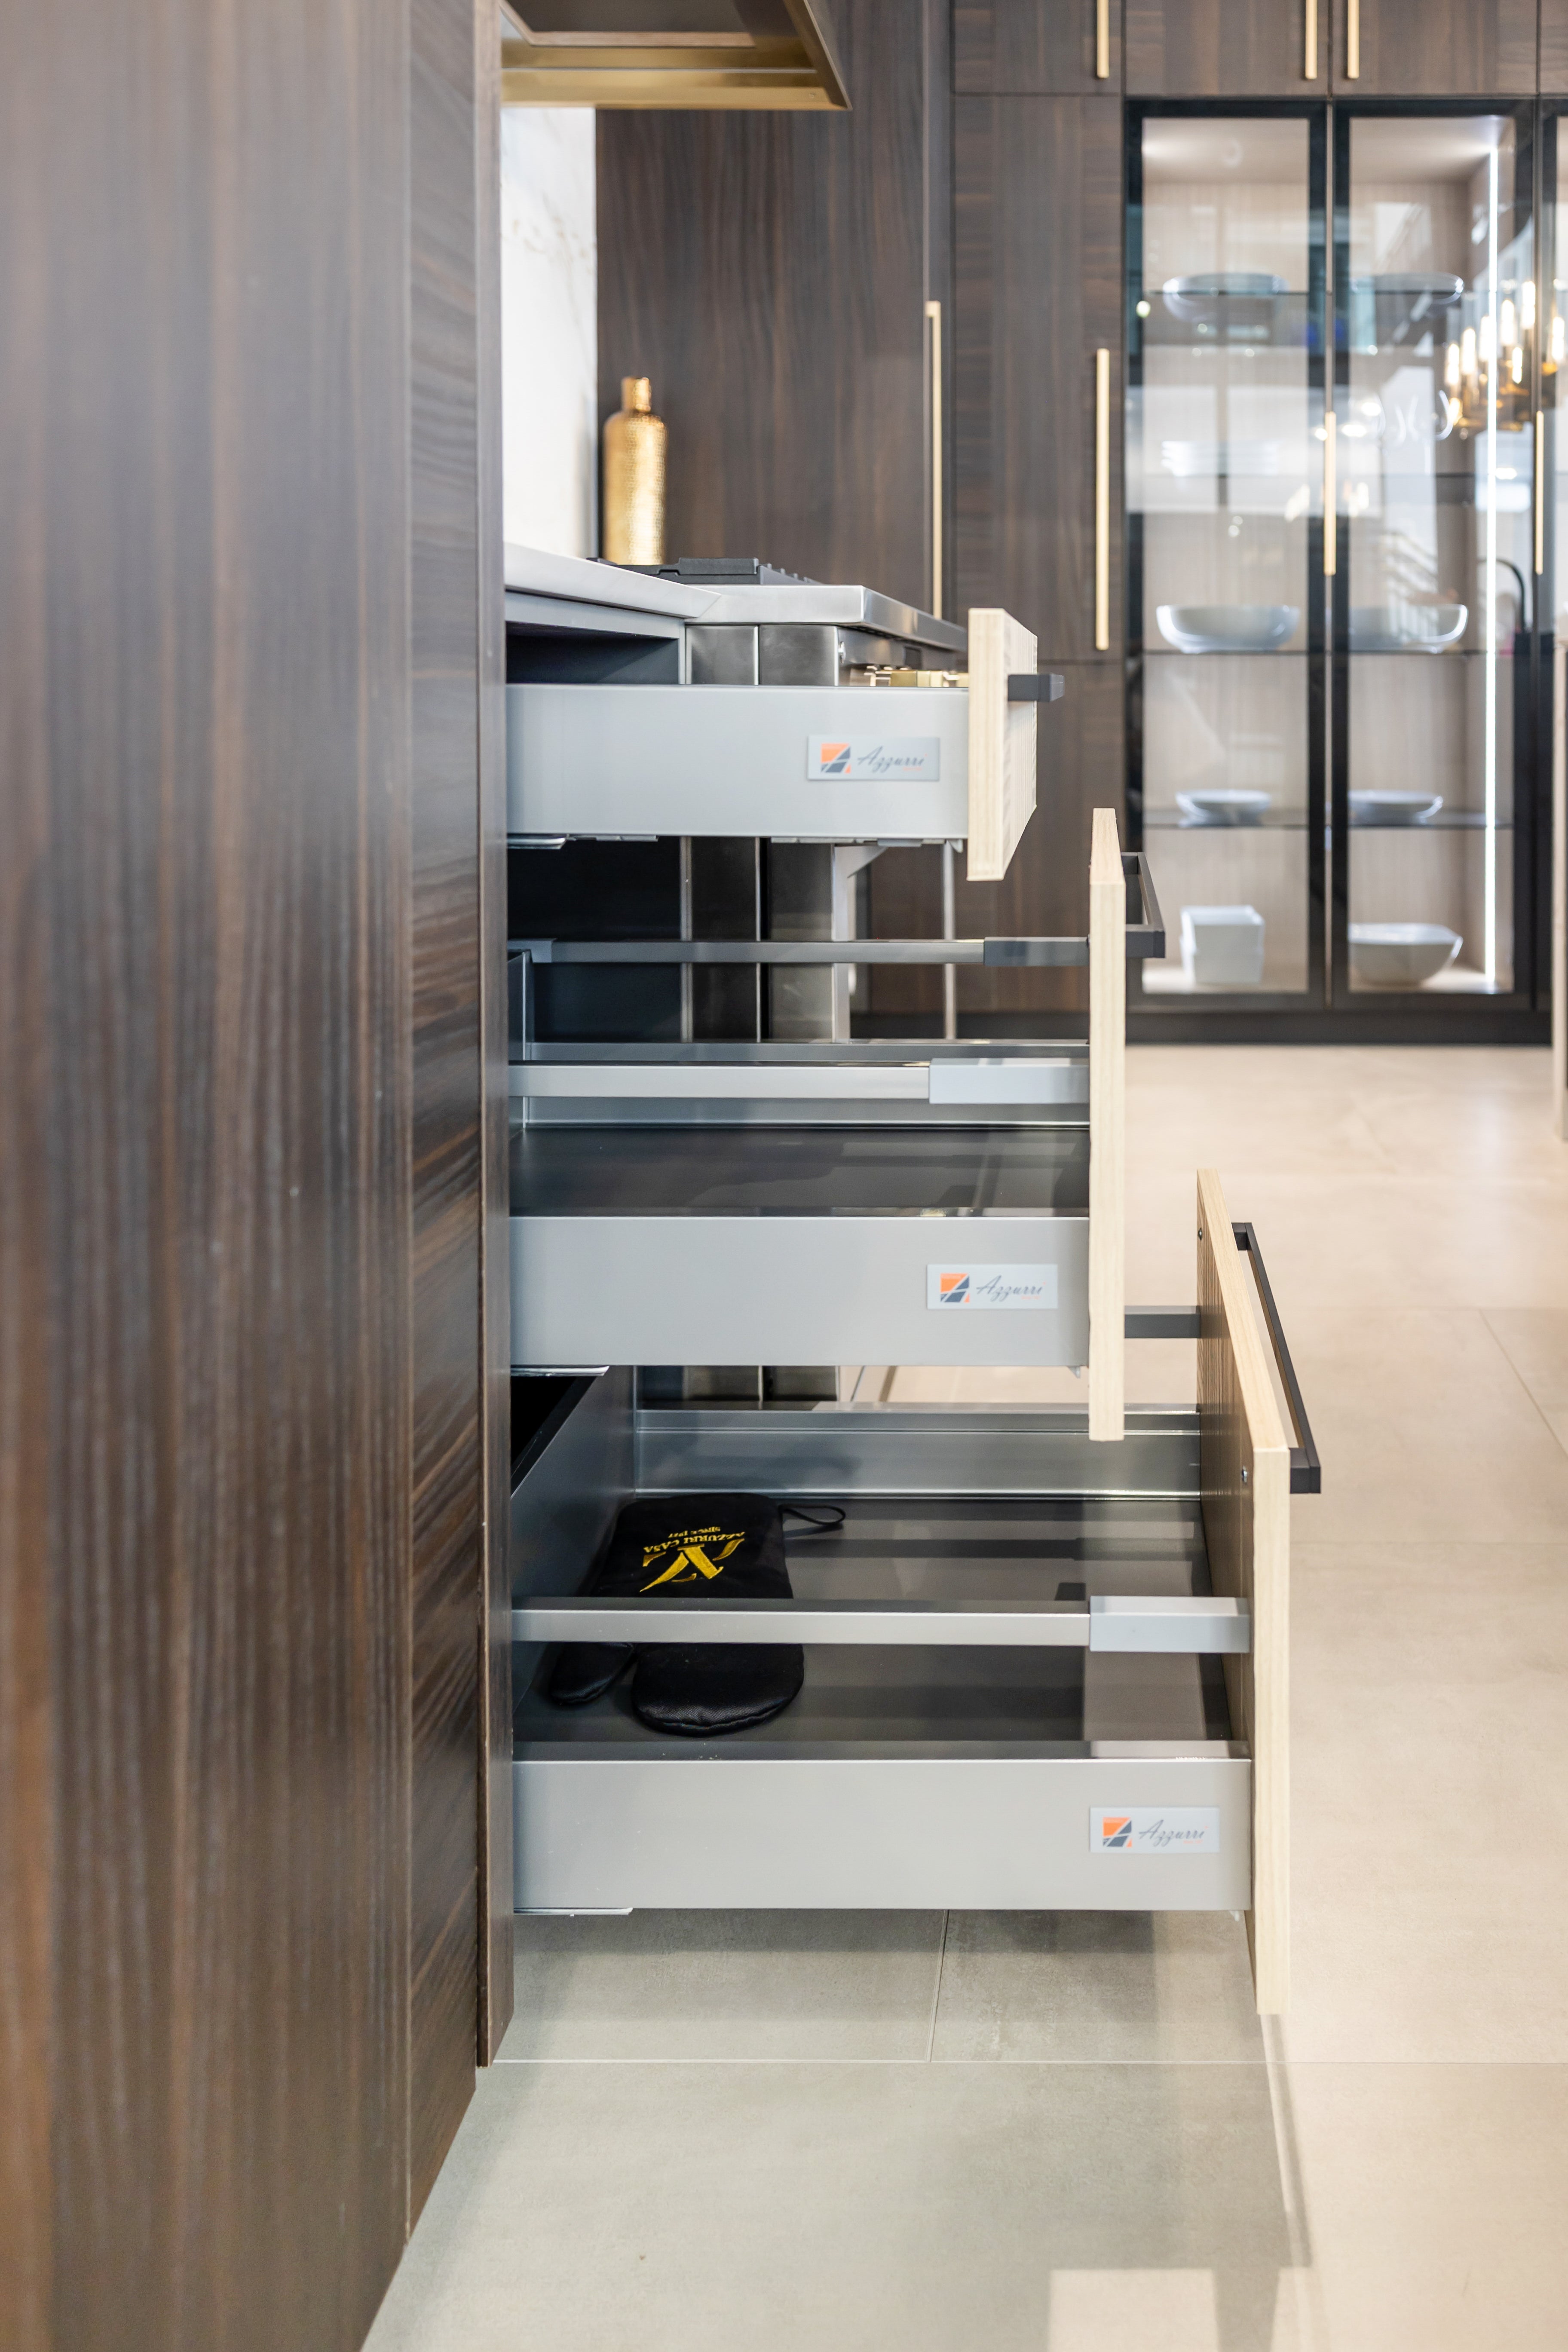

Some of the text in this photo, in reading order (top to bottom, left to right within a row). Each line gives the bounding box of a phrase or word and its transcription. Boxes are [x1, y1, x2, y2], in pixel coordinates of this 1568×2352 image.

[976, 1275, 1046, 1302] Azzurri
[643, 1531, 745, 1553] AZZURRI CASA
[1138, 1819, 1209, 1847] Azzurri
